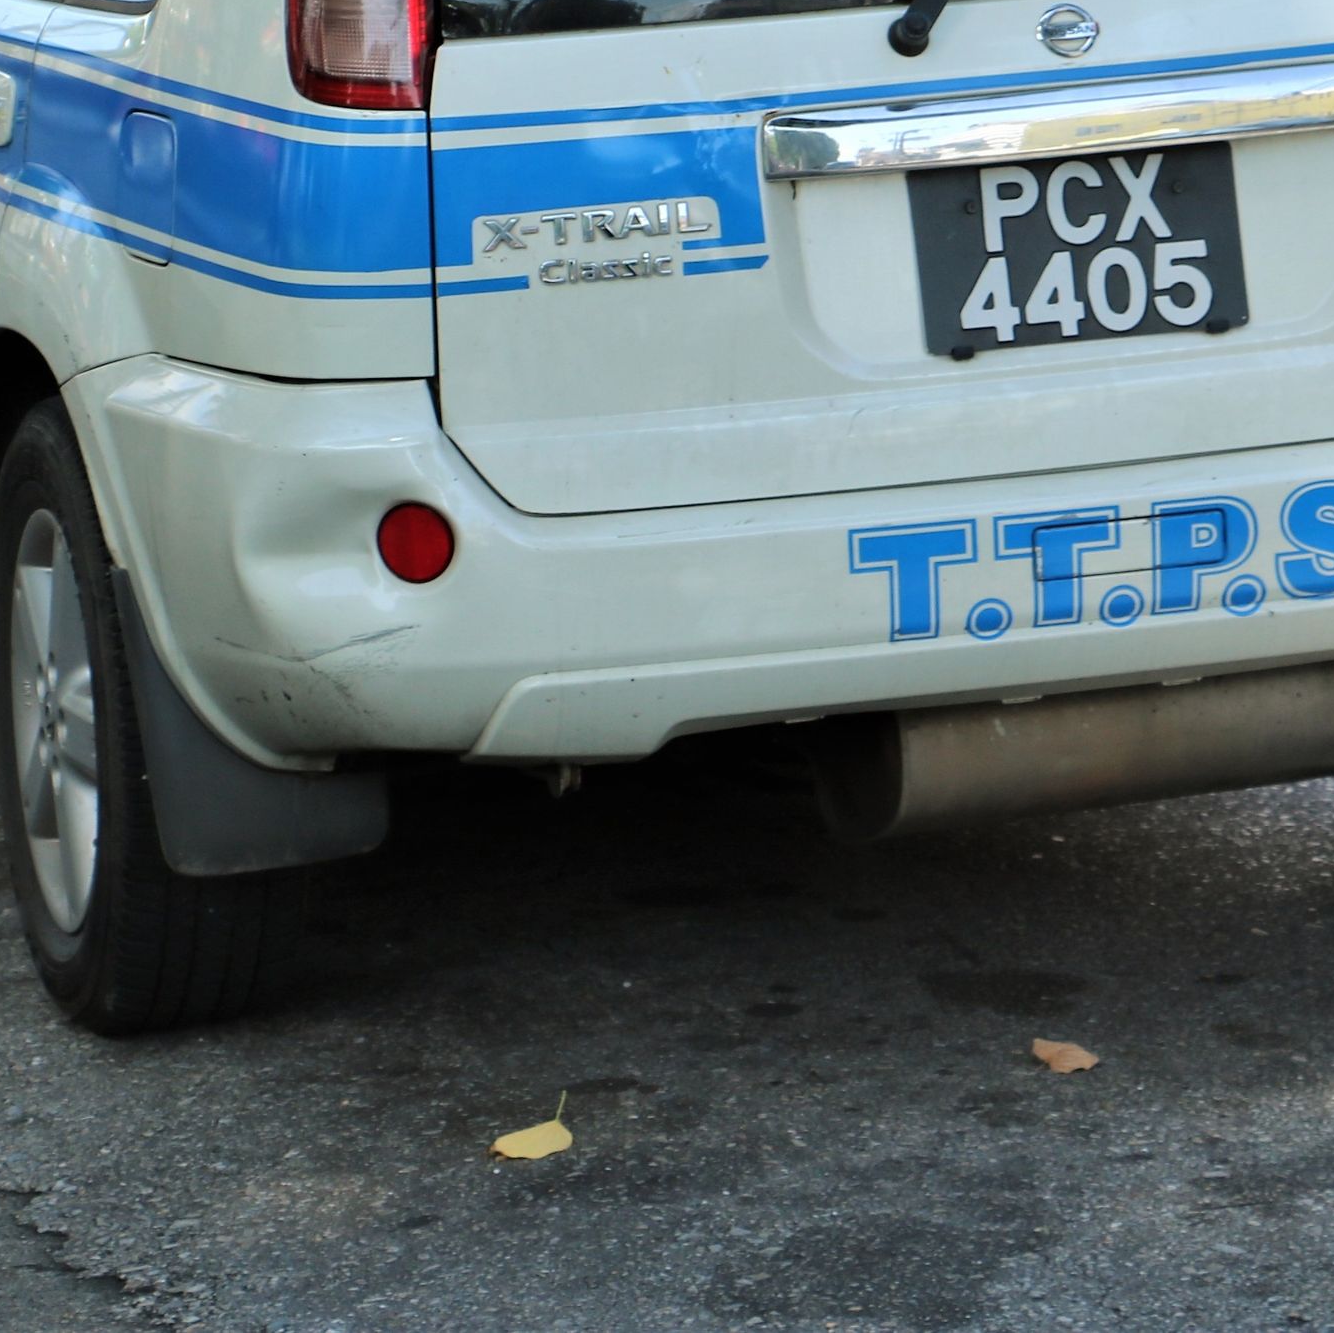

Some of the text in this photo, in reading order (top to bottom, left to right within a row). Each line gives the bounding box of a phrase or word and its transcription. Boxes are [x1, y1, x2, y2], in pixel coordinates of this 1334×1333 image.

[482, 201, 713, 253] X-TRAIL
[979, 153, 1173, 253] PCX
[538, 251, 673, 286] Classic
[960, 239, 1213, 342] 4405
